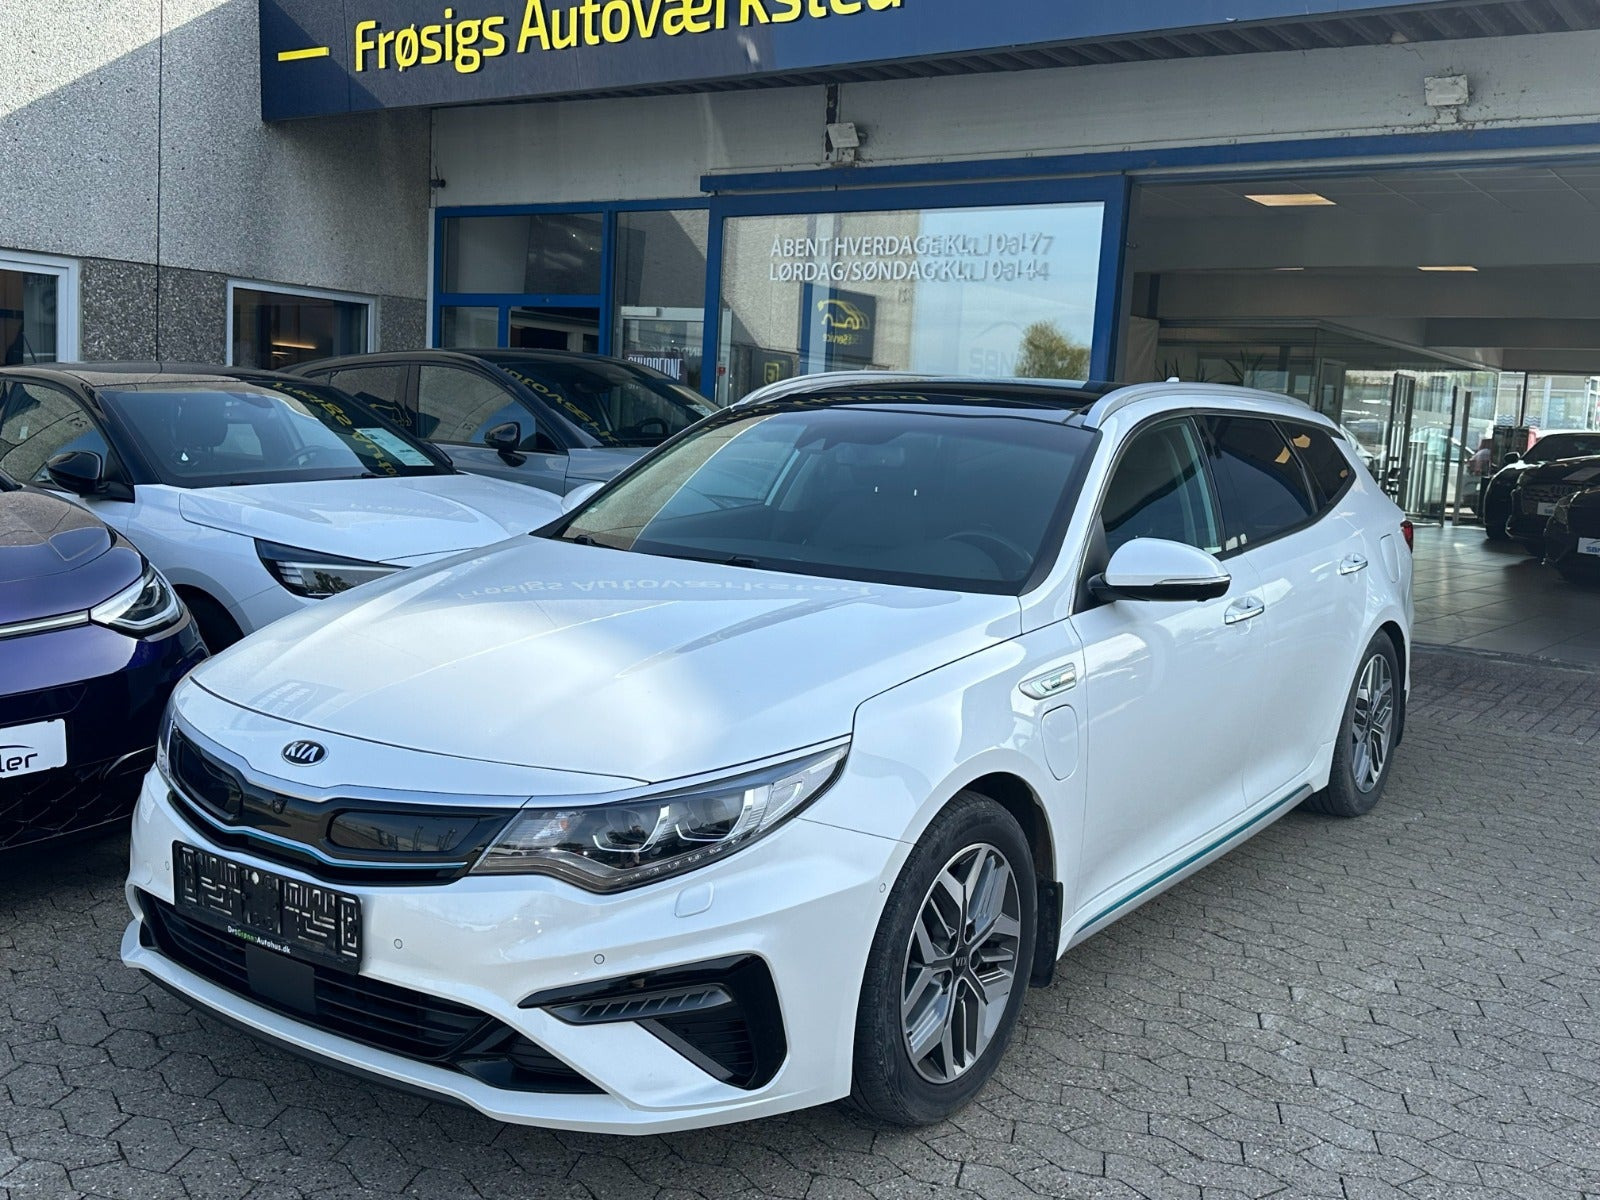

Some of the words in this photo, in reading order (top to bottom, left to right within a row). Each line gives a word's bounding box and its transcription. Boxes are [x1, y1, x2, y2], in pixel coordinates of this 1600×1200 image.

[355, 6, 506, 74] Frøsigs
[516, 0, 901, 53] Autoværks
[770, 233, 831, 257] ÅBENT
[834, 236, 944, 257] HVERDAGE
[769, 259, 935, 282] LØRDAG/SØNDAG
[285, 741, 320, 762] KIA
